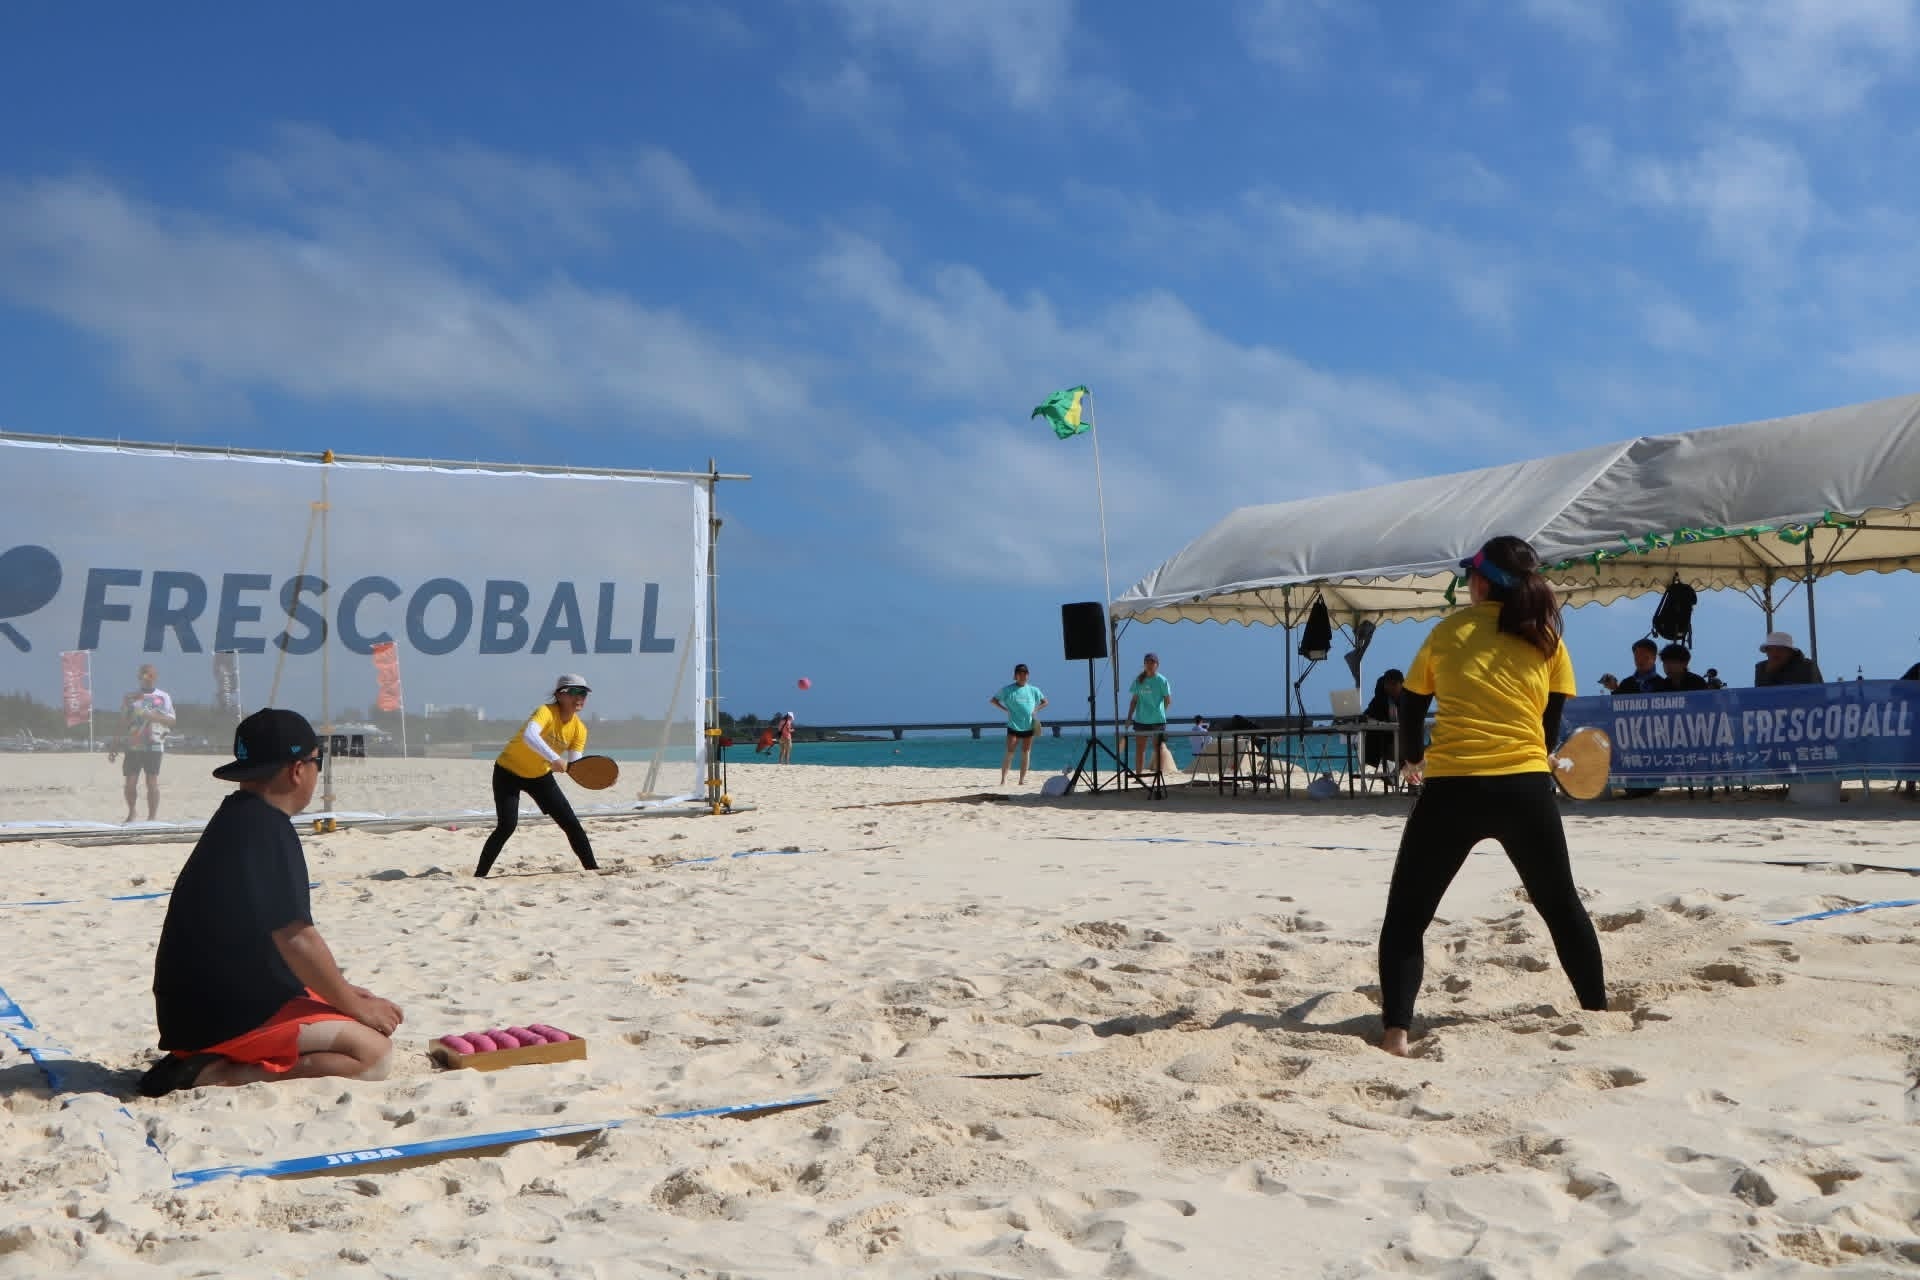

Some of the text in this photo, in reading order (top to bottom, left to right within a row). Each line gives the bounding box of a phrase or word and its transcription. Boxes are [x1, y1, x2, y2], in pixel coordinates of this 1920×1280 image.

[77, 567, 676, 656] FRESCOBALL
[1613, 696, 1686, 712] MIYAKO ISLAND
[1615, 701, 1913, 750] OKINAWA FRESCOBALL
[326, 1147, 404, 1165] JFBA
